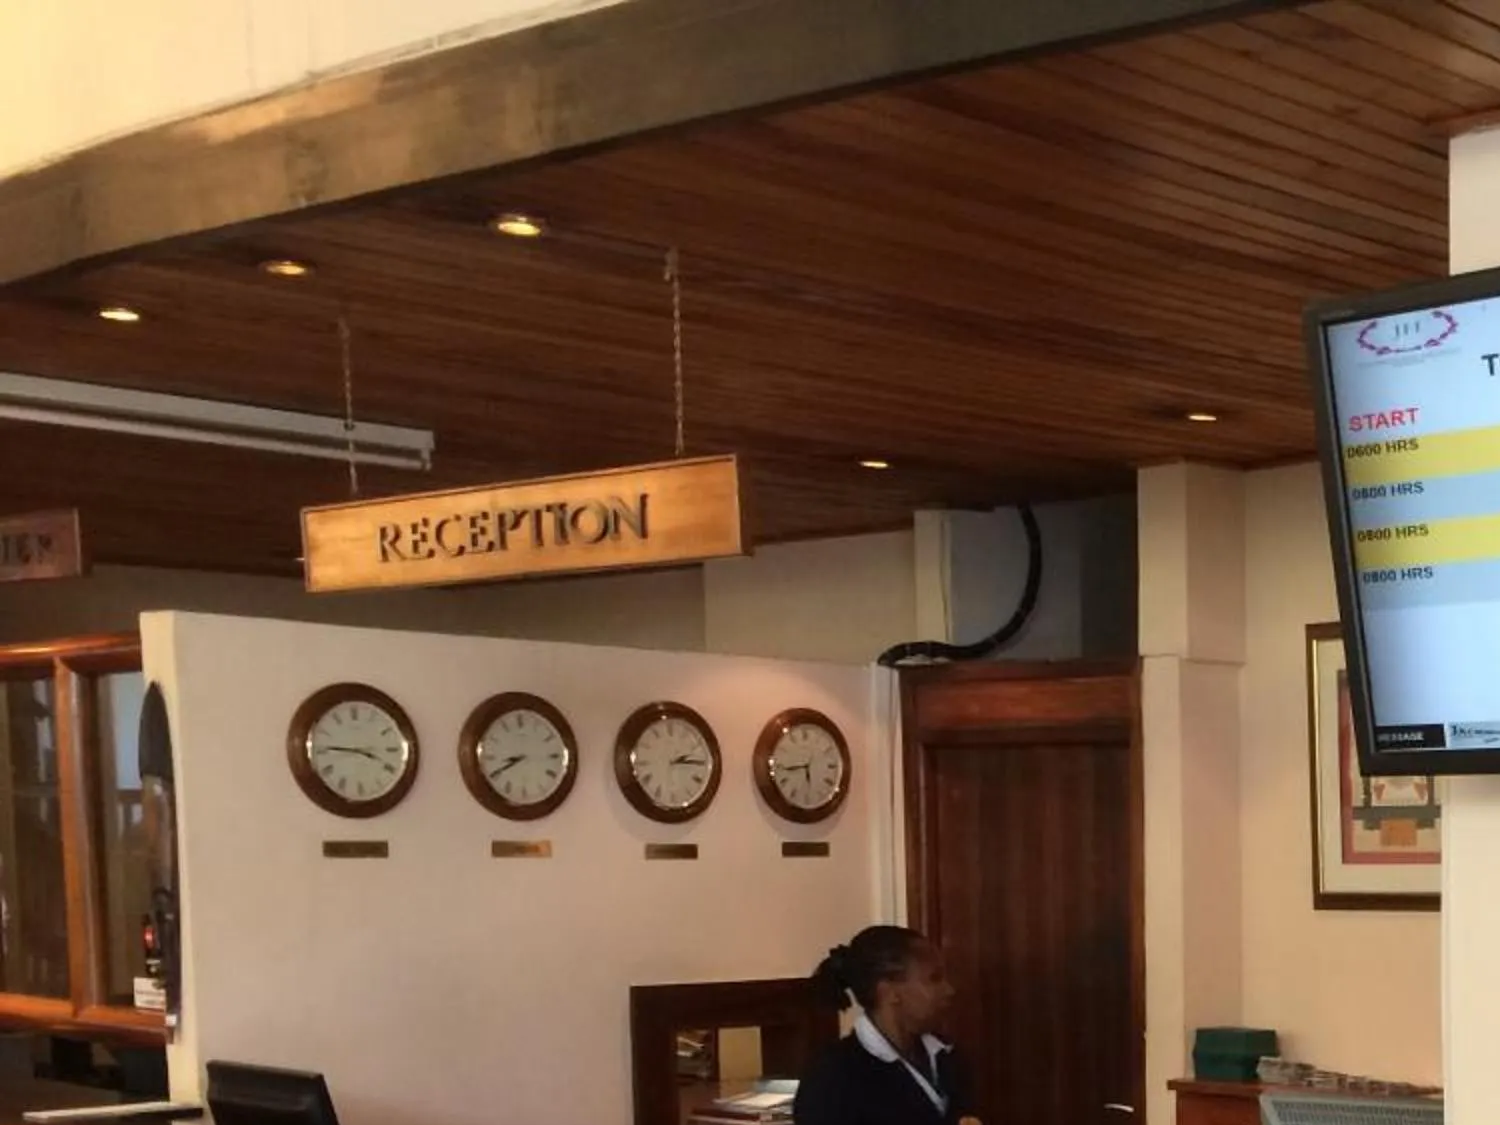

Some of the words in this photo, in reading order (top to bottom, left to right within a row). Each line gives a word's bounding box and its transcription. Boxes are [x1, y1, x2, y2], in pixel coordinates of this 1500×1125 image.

[1348, 407, 1419, 432] START
[1385, 438, 1420, 455] HRS
[1391, 481, 1425, 497] HRS
[378, 492, 650, 564] RECEPTION
[1395, 523, 1429, 540] HRS
[1400, 566, 1434, 581] HRS
